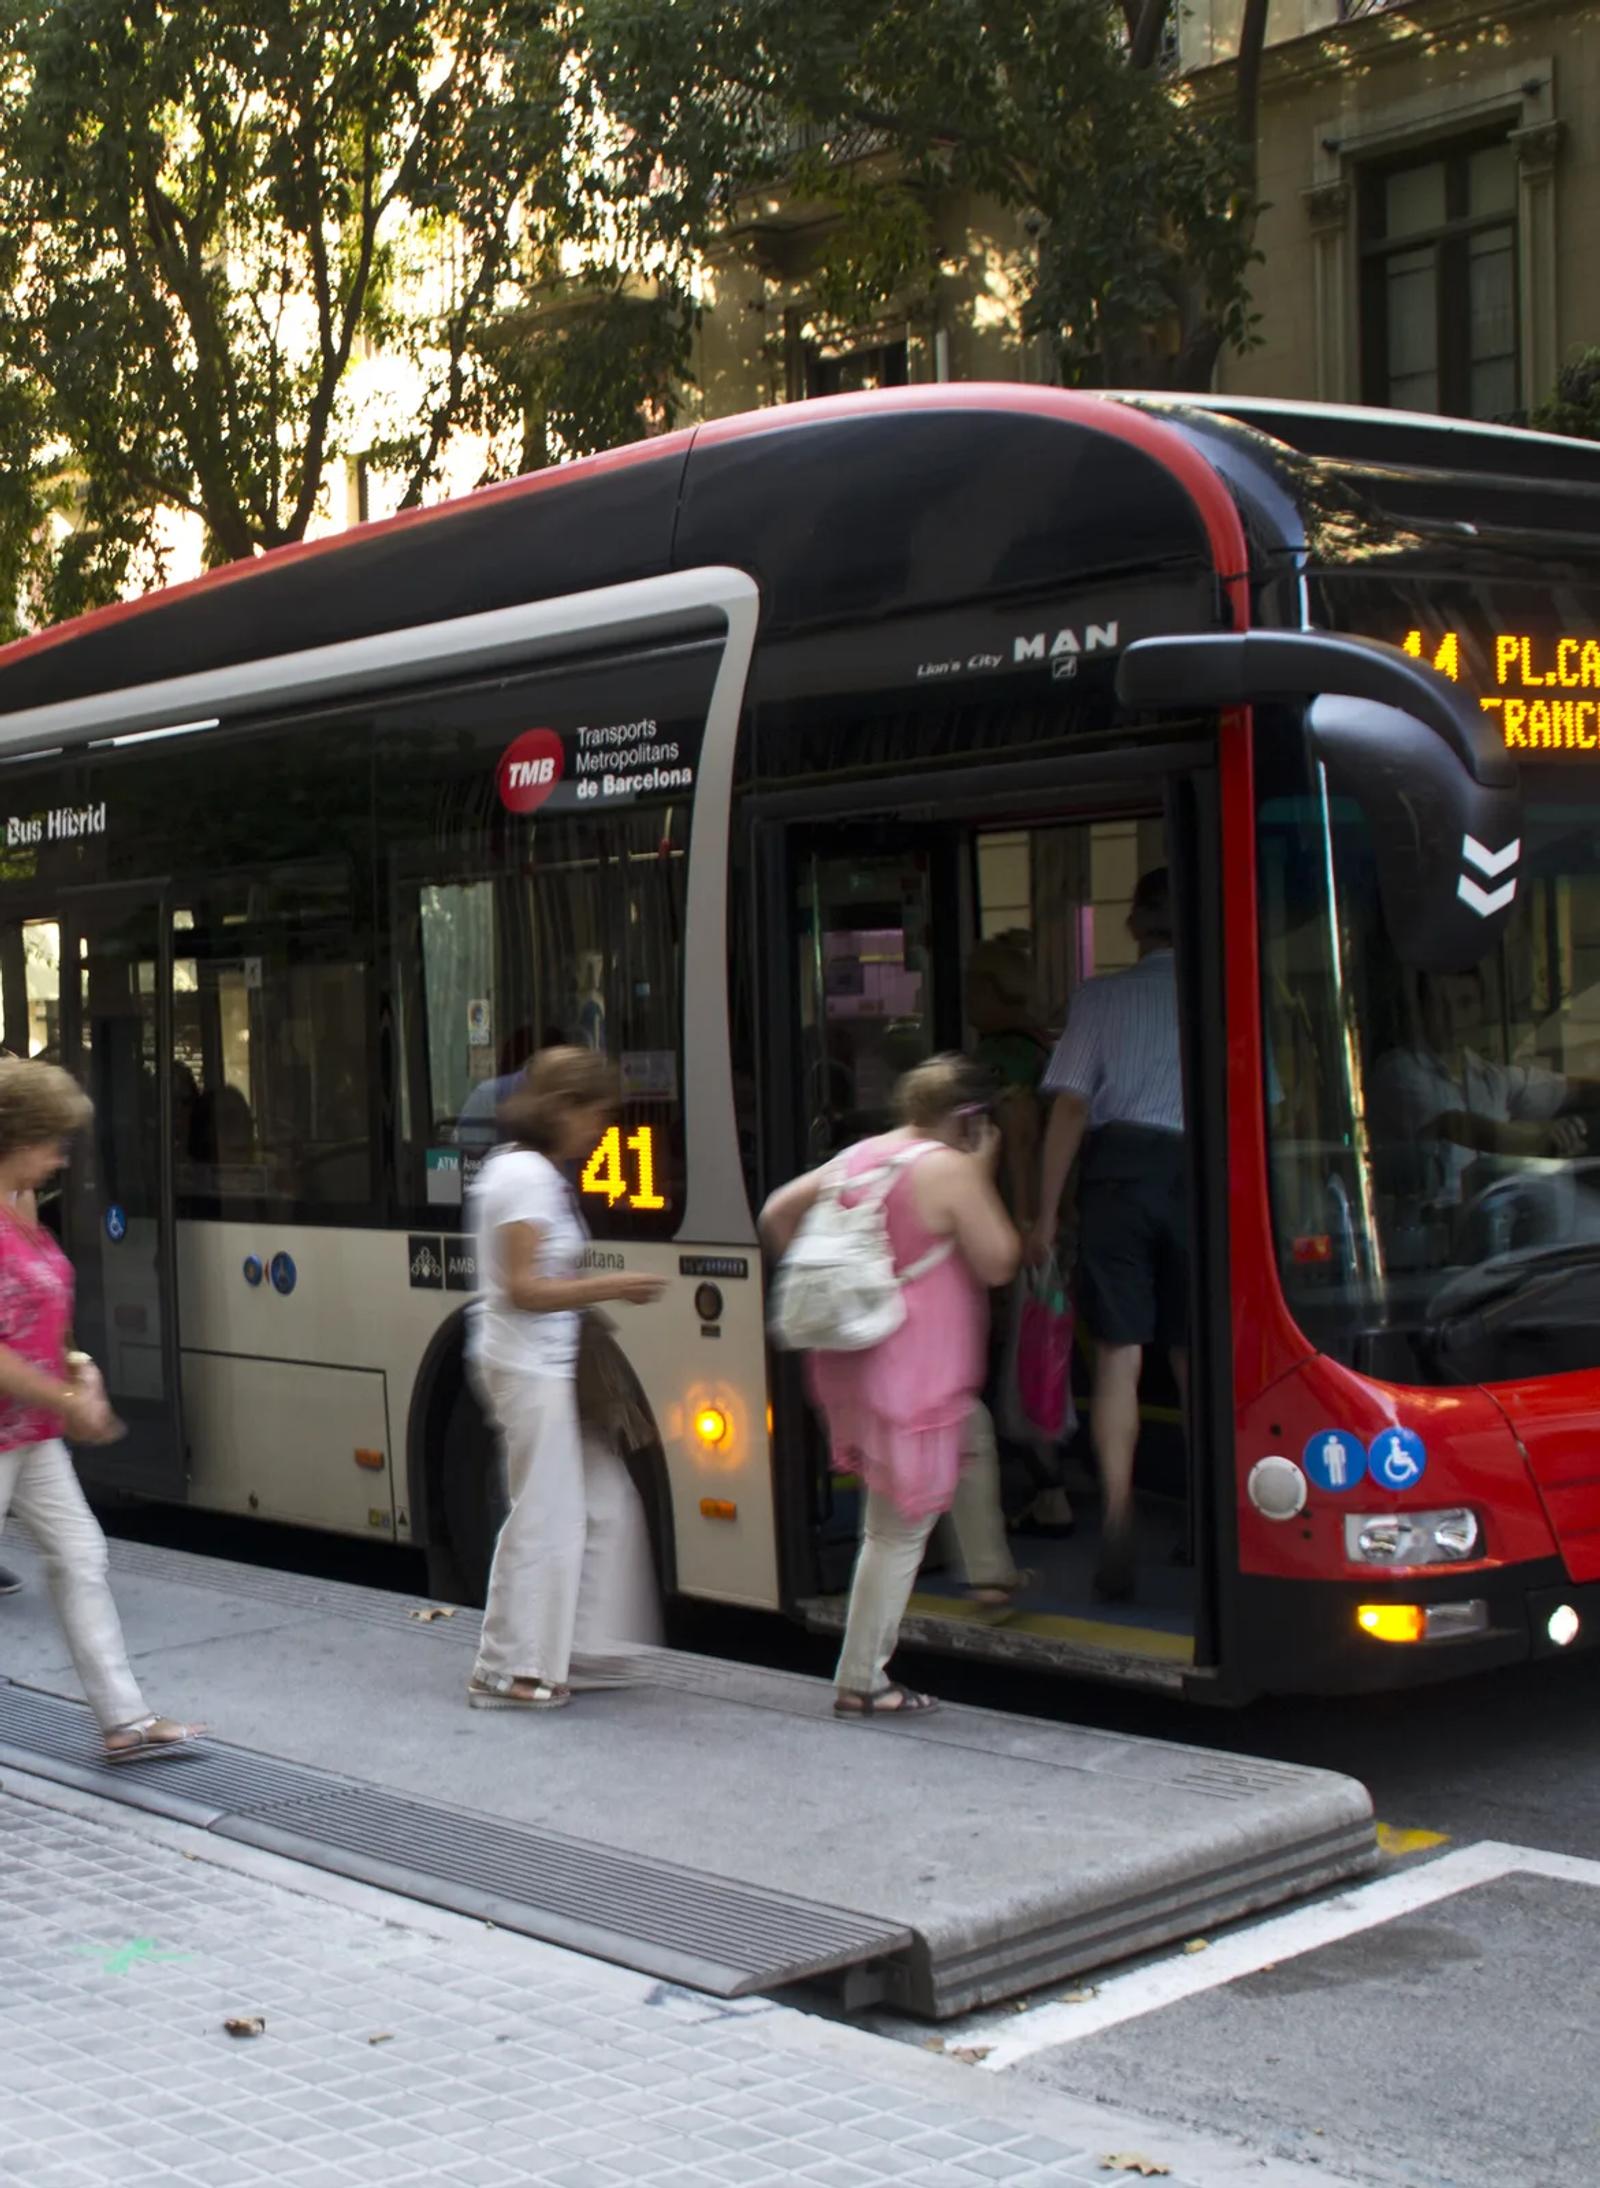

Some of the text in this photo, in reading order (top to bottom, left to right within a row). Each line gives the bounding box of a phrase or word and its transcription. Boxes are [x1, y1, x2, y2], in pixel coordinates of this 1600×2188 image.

[1014, 621, 1118, 662] MAN
[577, 719, 657, 747] Transports
[576, 743, 679, 773] Metropolitans
[509, 758, 555, 789] TMB
[577, 767, 692, 799] de Barcelona
[8, 816, 42, 846] Bus
[437, 1156, 459, 1171] ATM
[582, 1126, 664, 1208] 41
[449, 1257, 475, 1274] AMB
